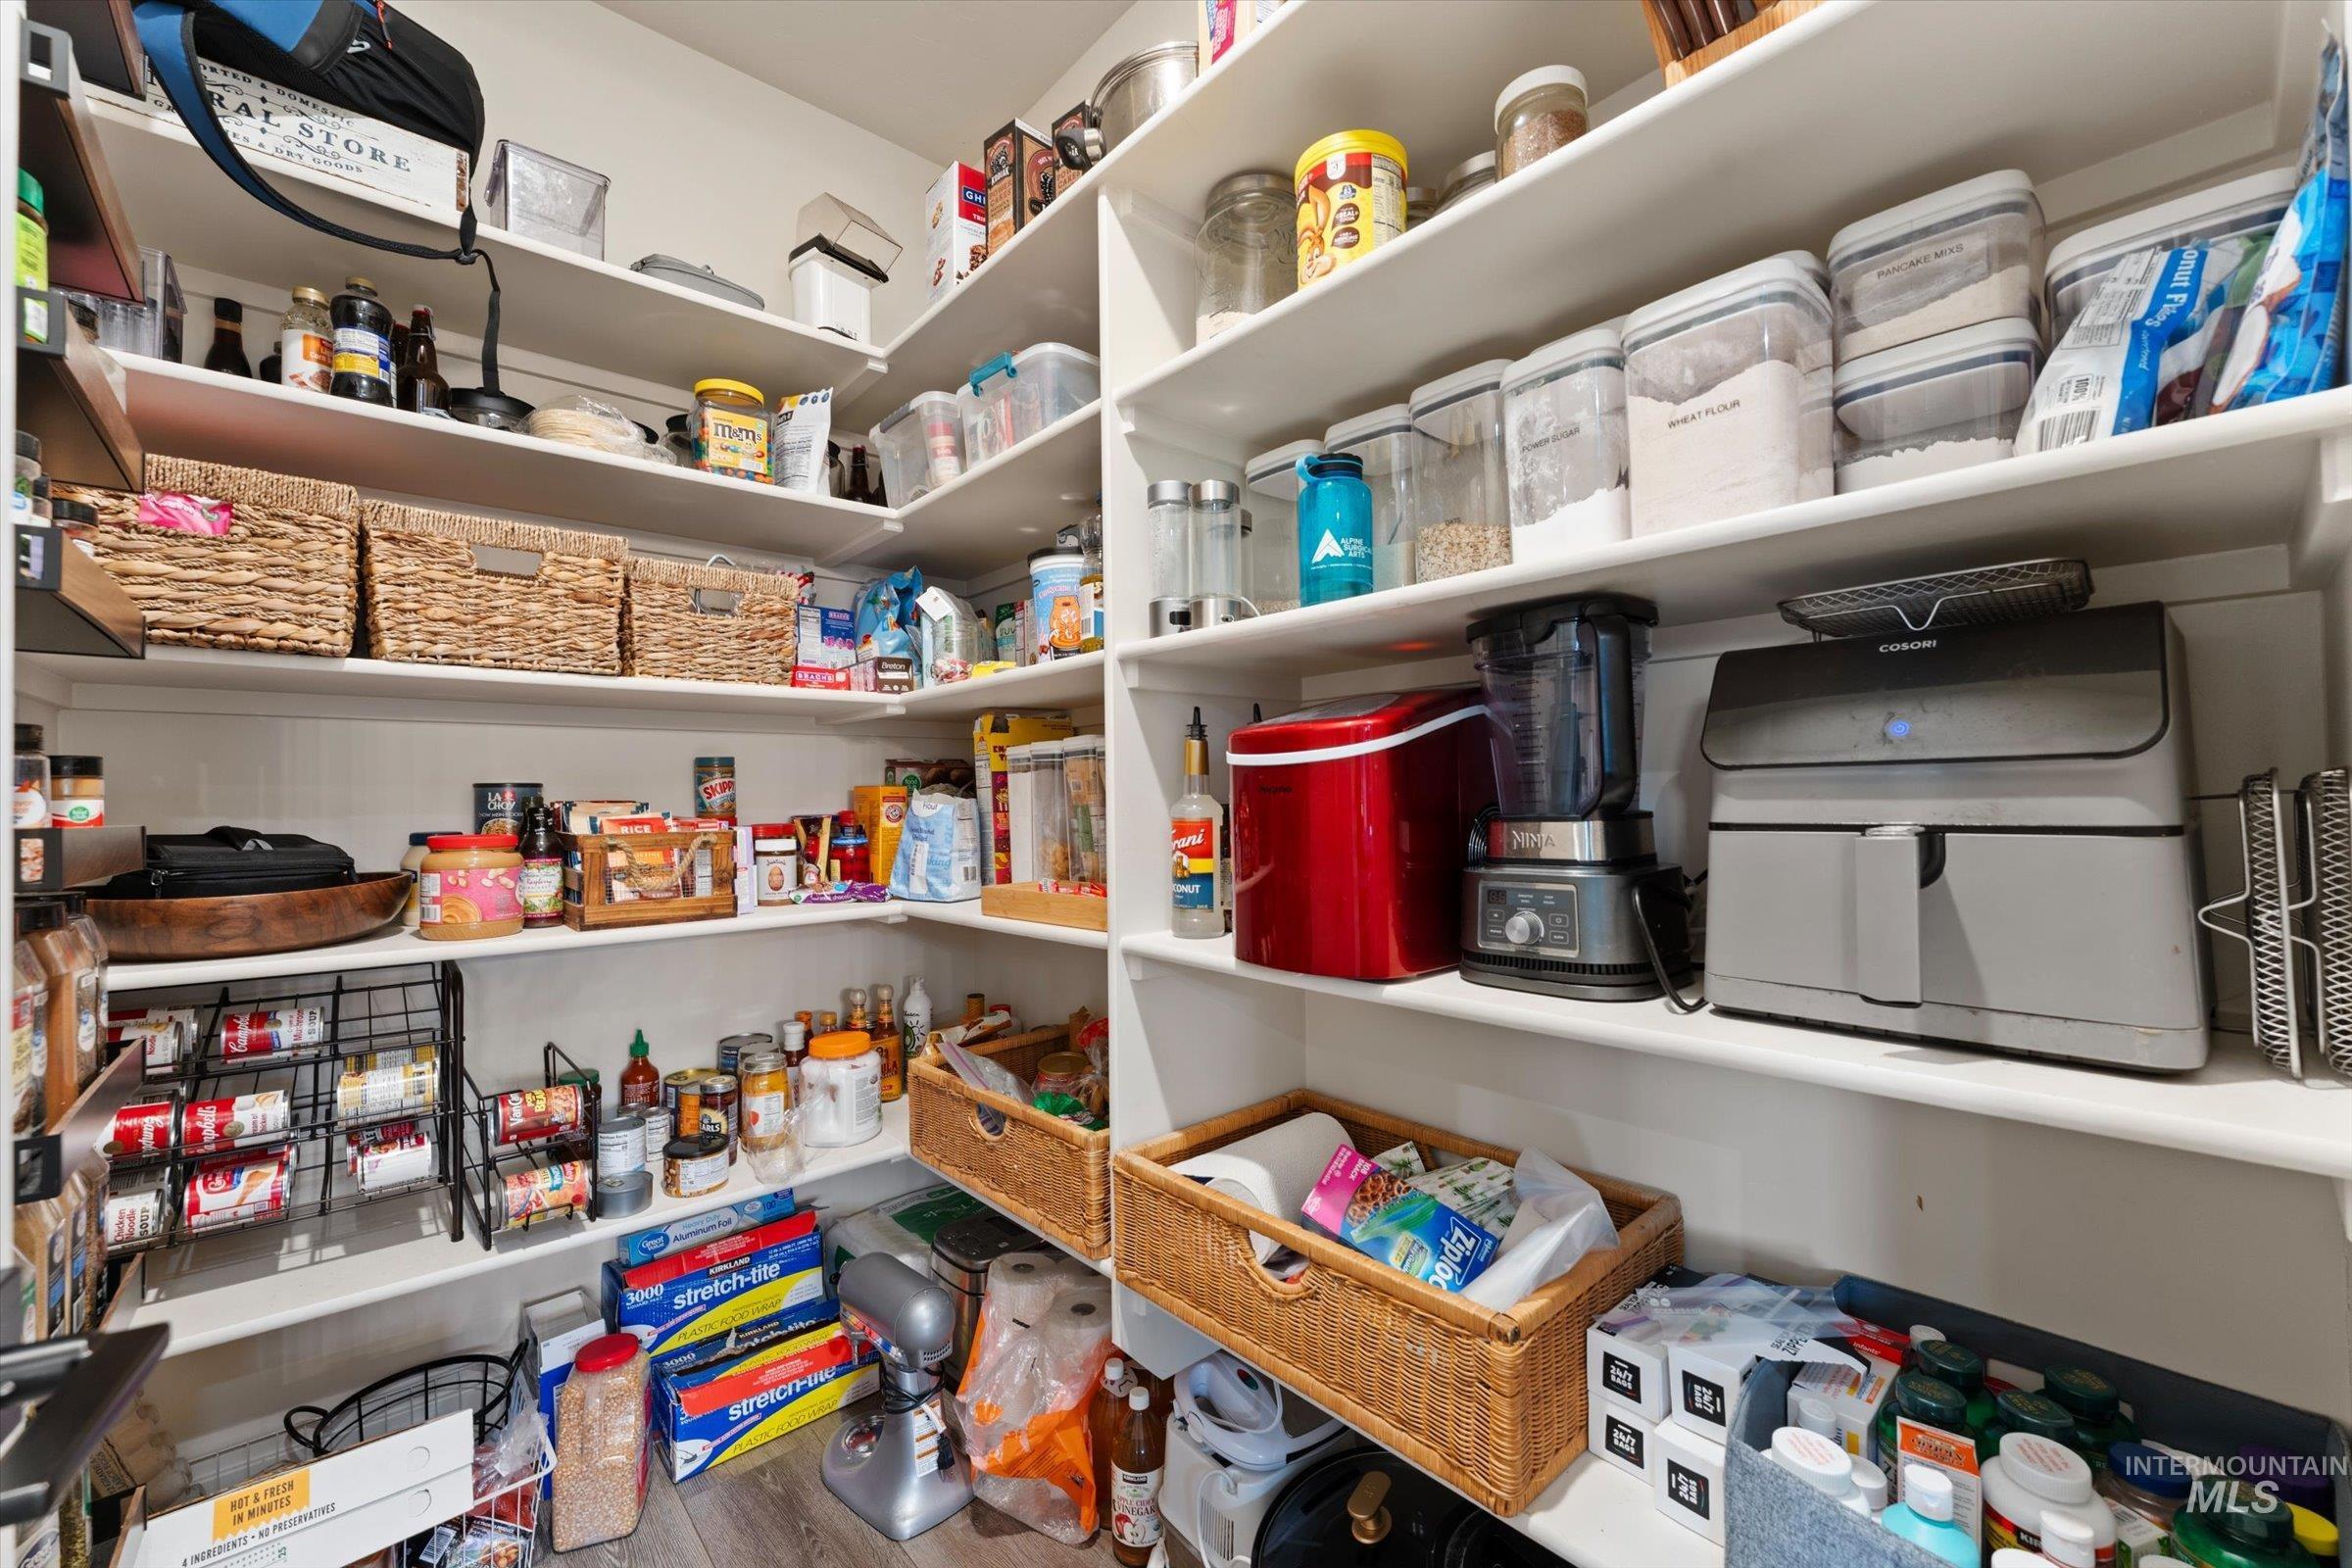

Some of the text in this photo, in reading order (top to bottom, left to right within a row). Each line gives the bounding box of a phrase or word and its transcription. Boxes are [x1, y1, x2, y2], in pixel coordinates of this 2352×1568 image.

[276, 87, 355, 126] DOMESTIC
[258, 141, 364, 173] & DRY GOODS
[298, 122, 411, 172] STORE
[1877, 243, 1964, 279] PANCAKE MIXS
[1667, 400, 1740, 429] WHEAT FLOUR
[1521, 427, 1581, 454] POWER SUGAR
[1879, 640, 1936, 653] COSORI
[487, 801, 515, 810] CHOY
[488, 792, 501, 802] LA
[1512, 830, 1556, 850] NINJA
[308, 1009, 317, 1038] SOUP
[763, 1200, 776, 1211] 100
[115, 1208, 125, 1242] Chicken
[126, 1208, 136, 1240] Noodle
[140, 1206, 150, 1237] SOUP
[672, 1218, 732, 1243] Aluminum Foil
[682, 1213, 720, 1229] Heavy Duty
[642, 1235, 664, 1249] Great
[710, 1256, 750, 1275] KIRKLAND
[626, 1284, 663, 1306] 3000
[673, 1262, 780, 1310] stretch-tite
[677, 1321, 717, 1342] PLASTIC
[720, 1310, 750, 1328] FOOD
[751, 1298, 783, 1316] WRAP
[739, 1322, 780, 1339] KIRKLAND
[1610, 1364, 1634, 1381] 24/7
[1610, 1374, 1634, 1391] BAGS
[1693, 1384, 1703, 1408] BAGS
[1701, 1386, 1715, 1414] 24/7
[733, 1430, 774, 1453] PLASTIC
[775, 1414, 807, 1433] FOOD
[807, 1399, 838, 1420] WRAP
[1612, 1428, 1636, 1446] 24/7
[1613, 1439, 1636, 1454] BAGS
[230, 1480, 294, 1512] HOT & FRESH
[1677, 1472, 1690, 1501] 24/7
[233, 1495, 291, 1526] IN MINUTES
[1117, 1502, 1156, 1516] VINEGAR
[182, 1502, 336, 1568] 4 INGREDIENTS NO PRESERVATIVES
